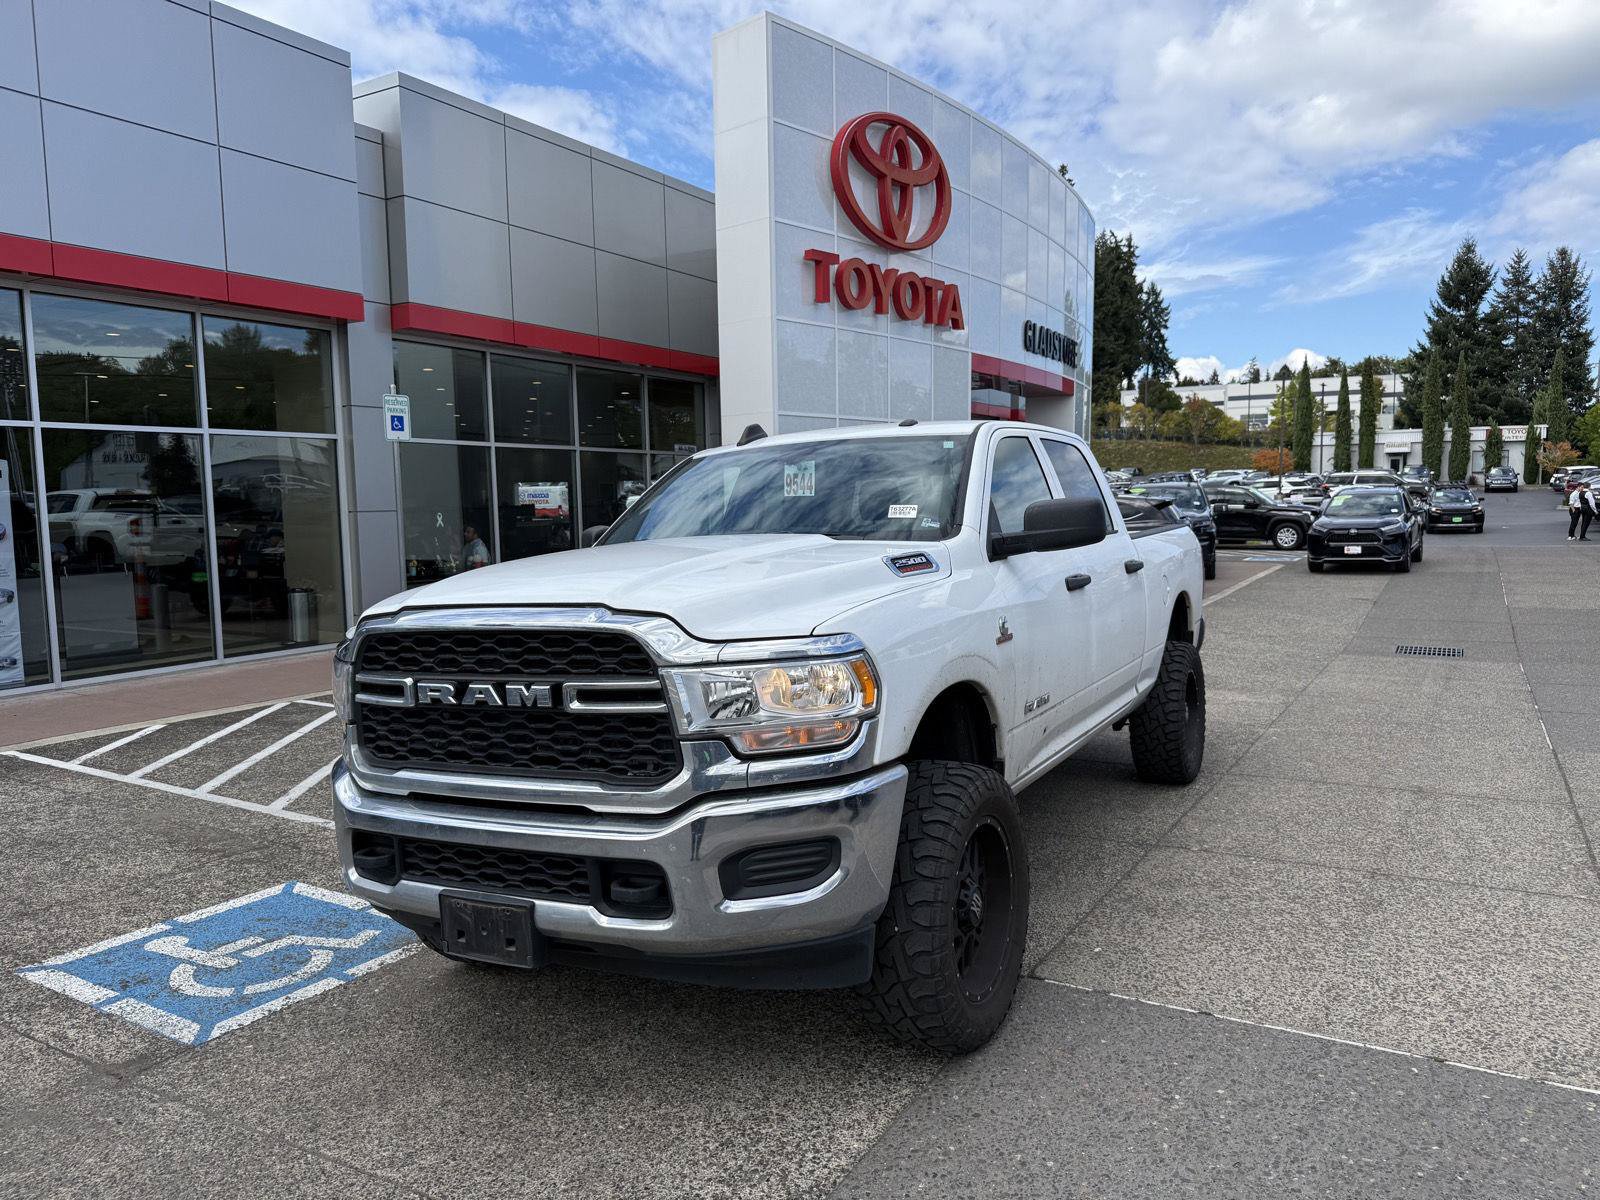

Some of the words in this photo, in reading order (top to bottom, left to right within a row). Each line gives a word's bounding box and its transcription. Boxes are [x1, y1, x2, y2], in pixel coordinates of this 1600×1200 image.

[803, 249, 965, 331] TOYOTA
[386, 407, 407, 415] PARKING
[785, 472, 814, 496] 9544
[894, 556, 927, 567] 2500
[417, 681, 553, 707] RAM
